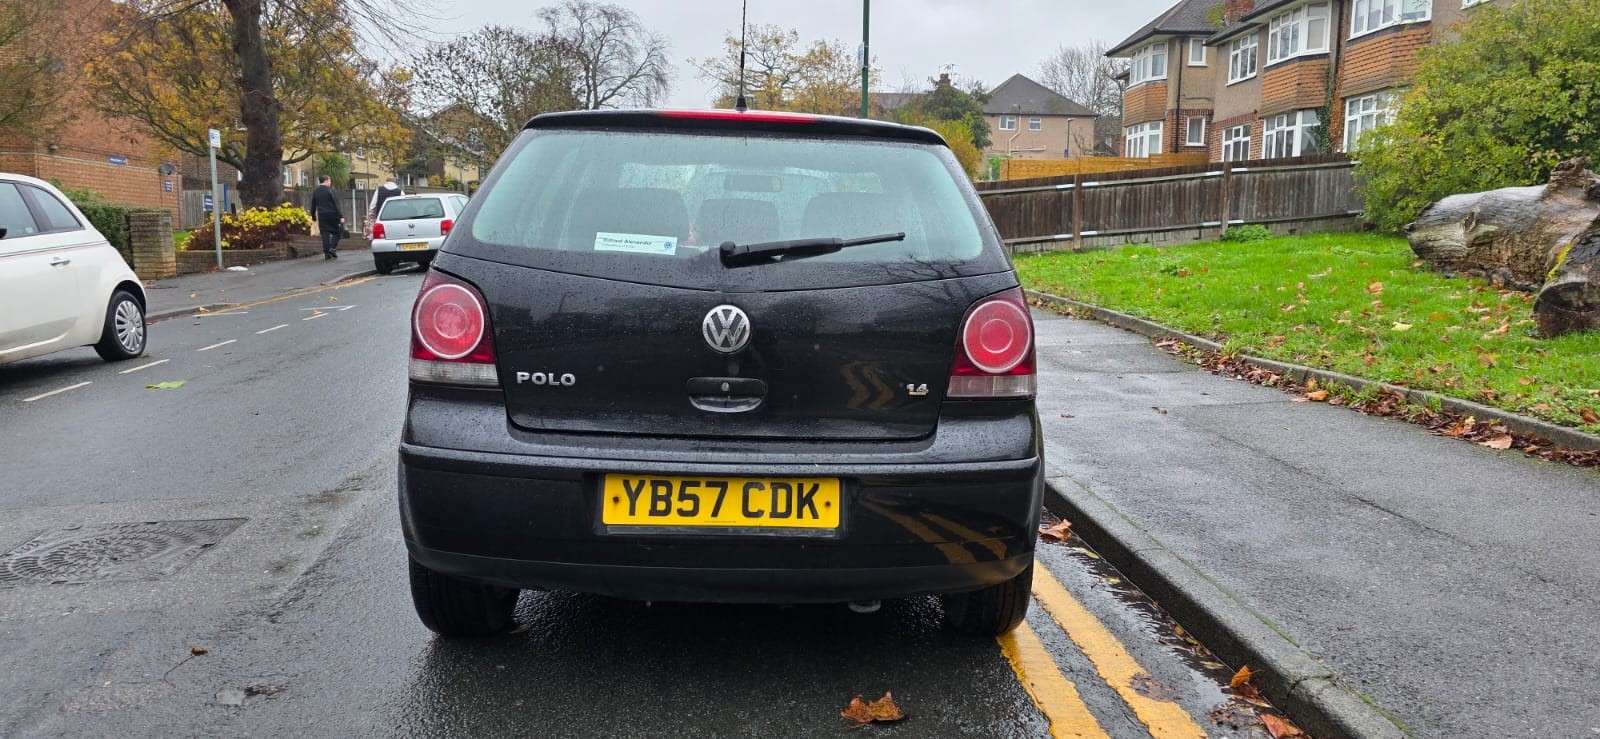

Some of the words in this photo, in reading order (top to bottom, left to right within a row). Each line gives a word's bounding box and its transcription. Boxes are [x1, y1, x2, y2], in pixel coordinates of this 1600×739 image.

[516, 371, 576, 387] POLO
[622, 479, 729, 518] YB57
[741, 481, 820, 520] CDK
